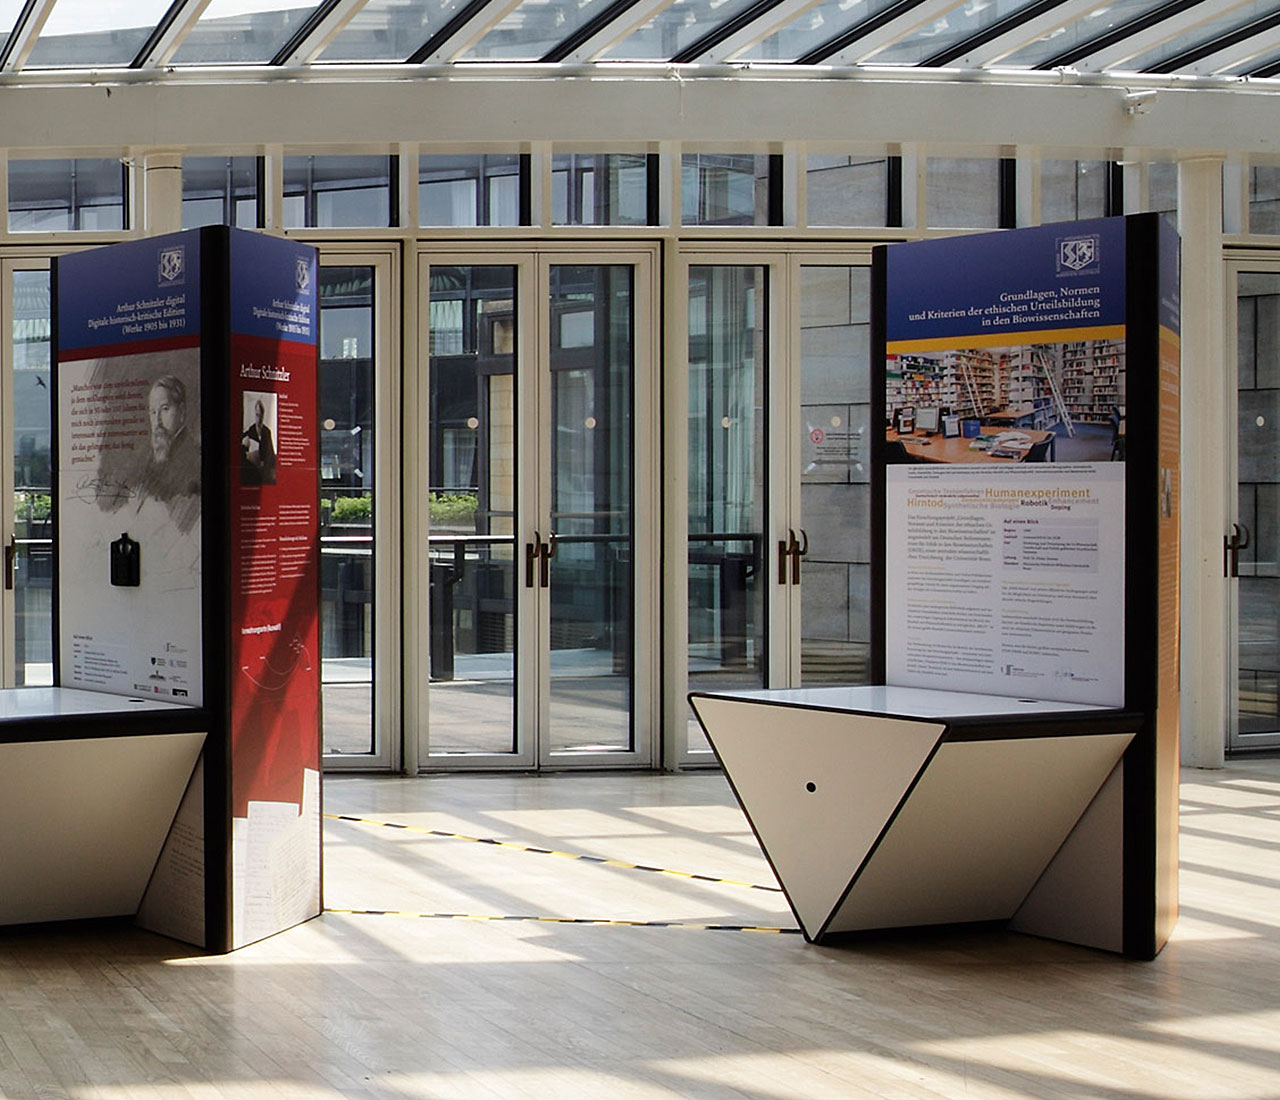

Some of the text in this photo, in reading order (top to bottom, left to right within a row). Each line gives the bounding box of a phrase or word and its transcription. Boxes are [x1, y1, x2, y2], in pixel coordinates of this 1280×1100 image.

[1000, 286, 1100, 303] Grundlagen, Normen
[116, 303, 135, 313] Arthur
[136, 298, 165, 310] Schnitzler
[163, 308, 185, 317] Edition
[909, 297, 1101, 322] und Kriterien der ethischen Urteilsbildung
[159, 321, 168, 330] bis
[982, 309, 1100, 327] in den Biowissenschaften
[240, 363, 290, 382] Arthur Schnitzler
[985, 488, 1091, 500] Humanexperiment
[907, 498, 943, 507] Hirntod
